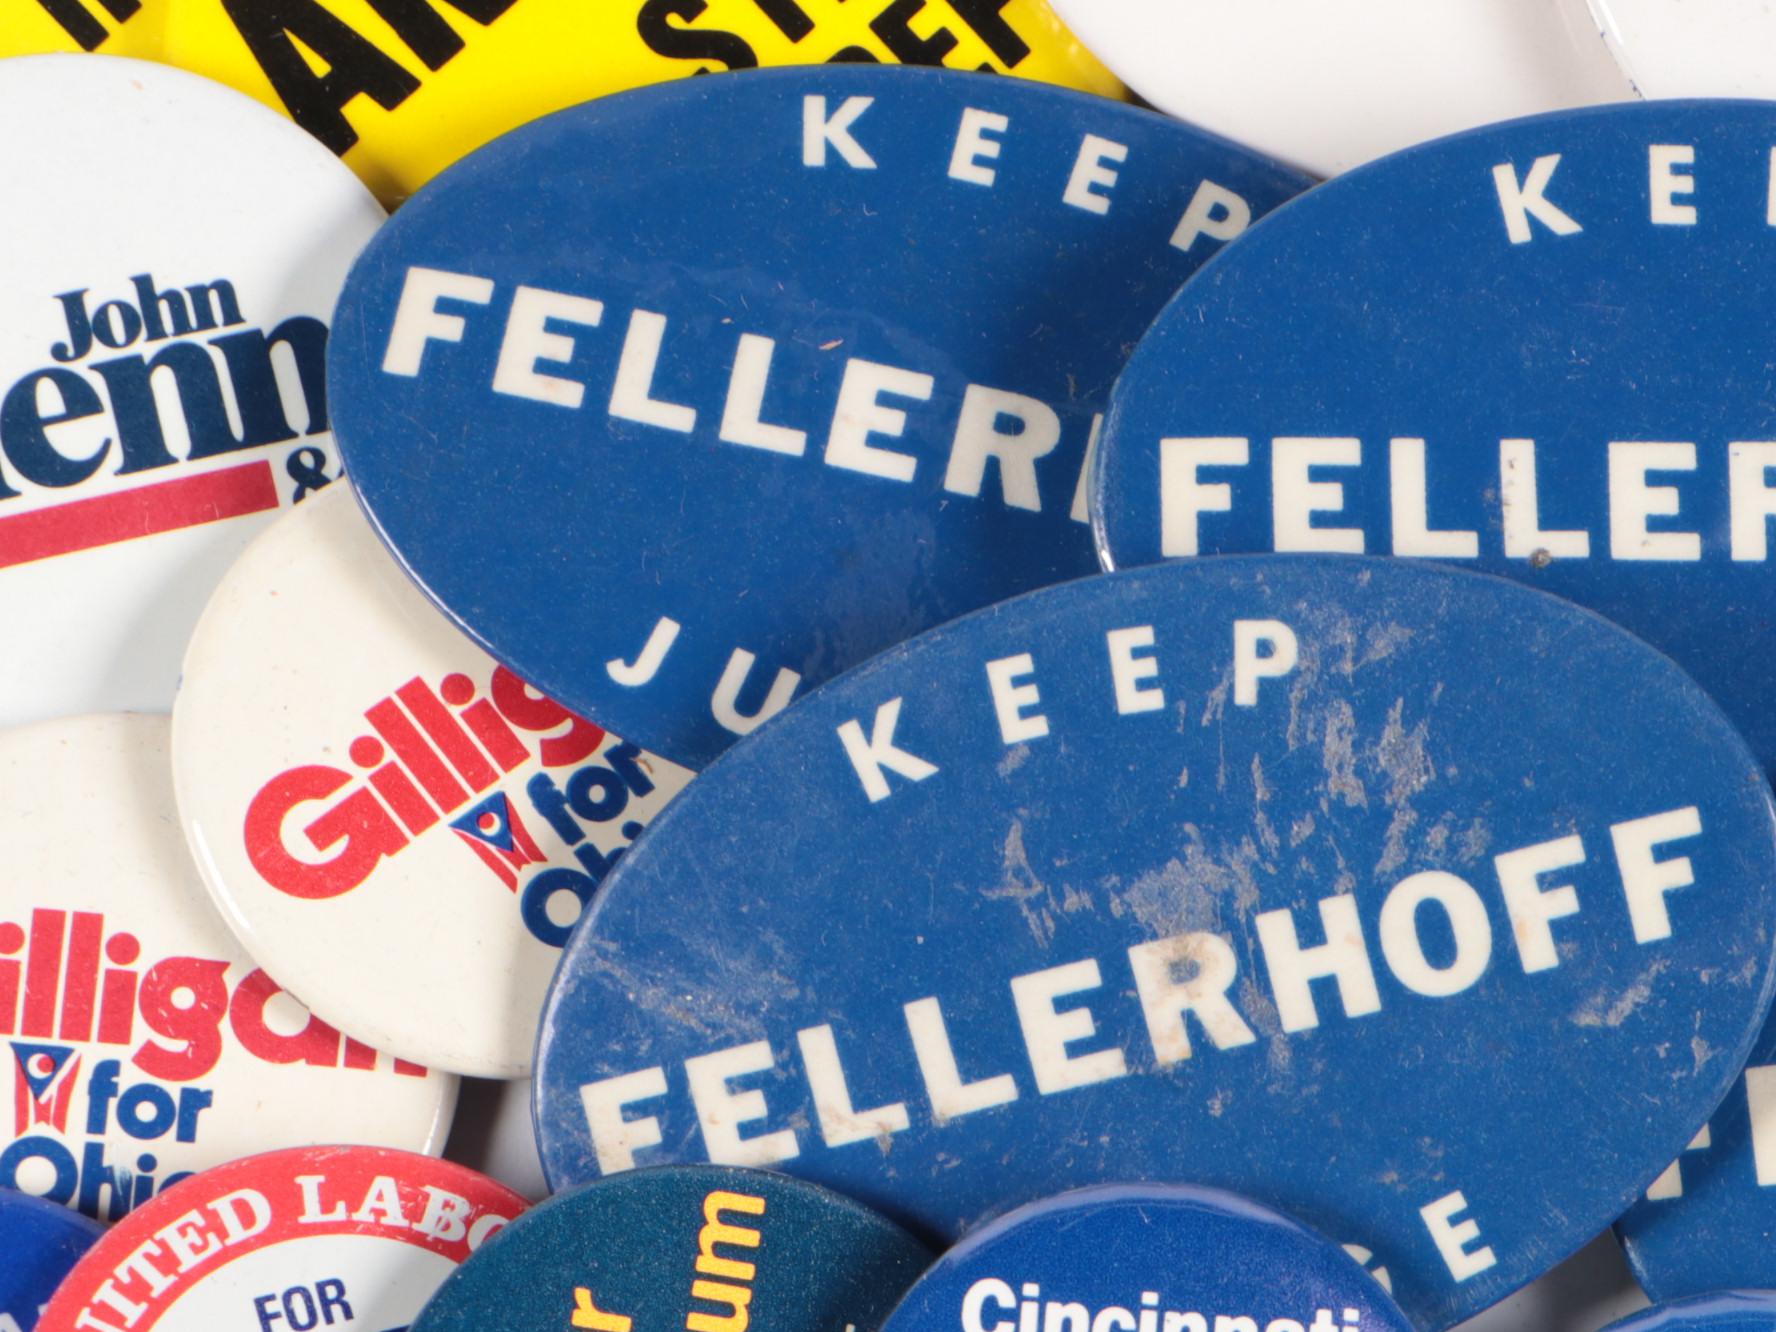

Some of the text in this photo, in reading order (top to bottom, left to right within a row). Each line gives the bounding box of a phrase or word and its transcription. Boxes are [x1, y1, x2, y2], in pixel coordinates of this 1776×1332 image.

[803, 95, 1251, 252] KEEP
[0, 316, 329, 502] enn
[51, 273, 245, 364] John
[382, 267, 1104, 525] FELLER
[243, 664, 606, 900] Gillig
[836, 619, 1299, 803] KEEP
[579, 806, 1702, 1177] FELLERHOFF
[0, 1136, 199, 1217] Ohi
[86, 1060, 213, 1143] for
